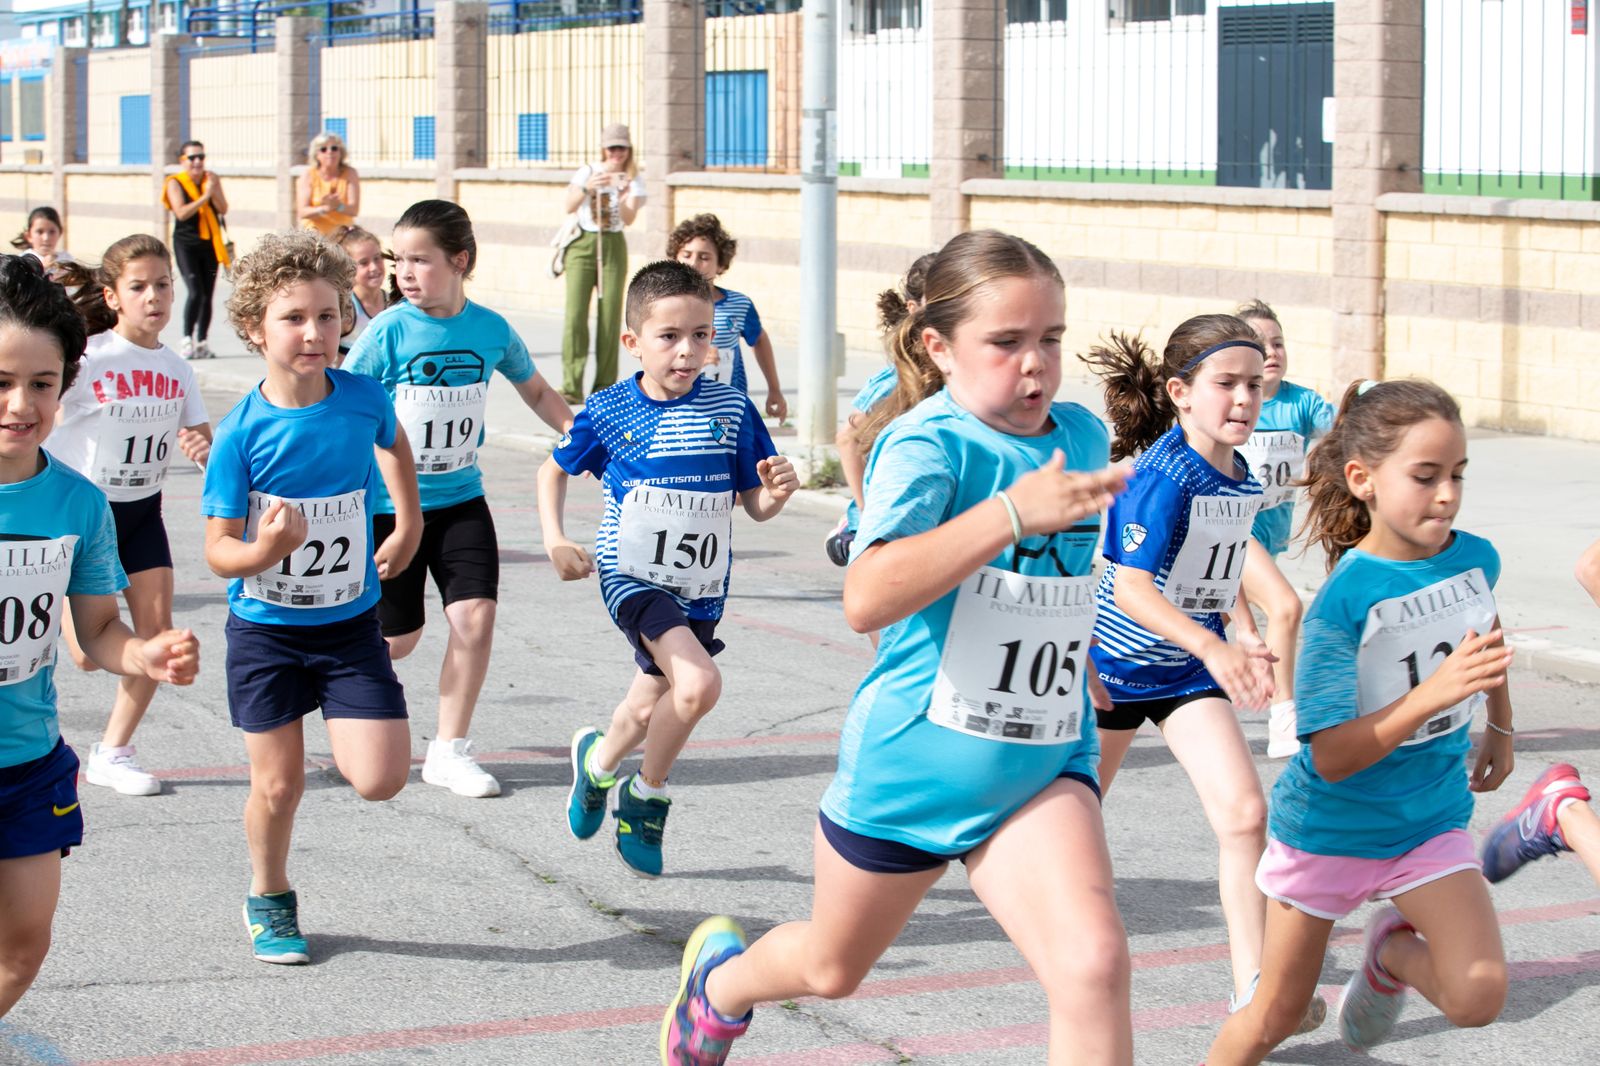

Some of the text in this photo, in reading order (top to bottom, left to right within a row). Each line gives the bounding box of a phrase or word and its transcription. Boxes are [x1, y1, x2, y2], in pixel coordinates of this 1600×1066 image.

[131, 401, 178, 418] MILLA
[426, 387, 482, 402] MILLA
[120, 430, 170, 464] 116
[420, 417, 474, 449] 119
[642, 475, 701, 487] ATLETISMO
[1259, 461, 1291, 490] 30
[660, 493, 729, 511] MILLA
[8, 543, 67, 568] ILLA
[276, 536, 350, 578] 122
[649, 529, 719, 570] 150
[973, 573, 1093, 607] II MILLA
[1400, 579, 1480, 623] MILLA
[0, 592, 54, 645] 08
[988, 639, 1081, 697] 105
